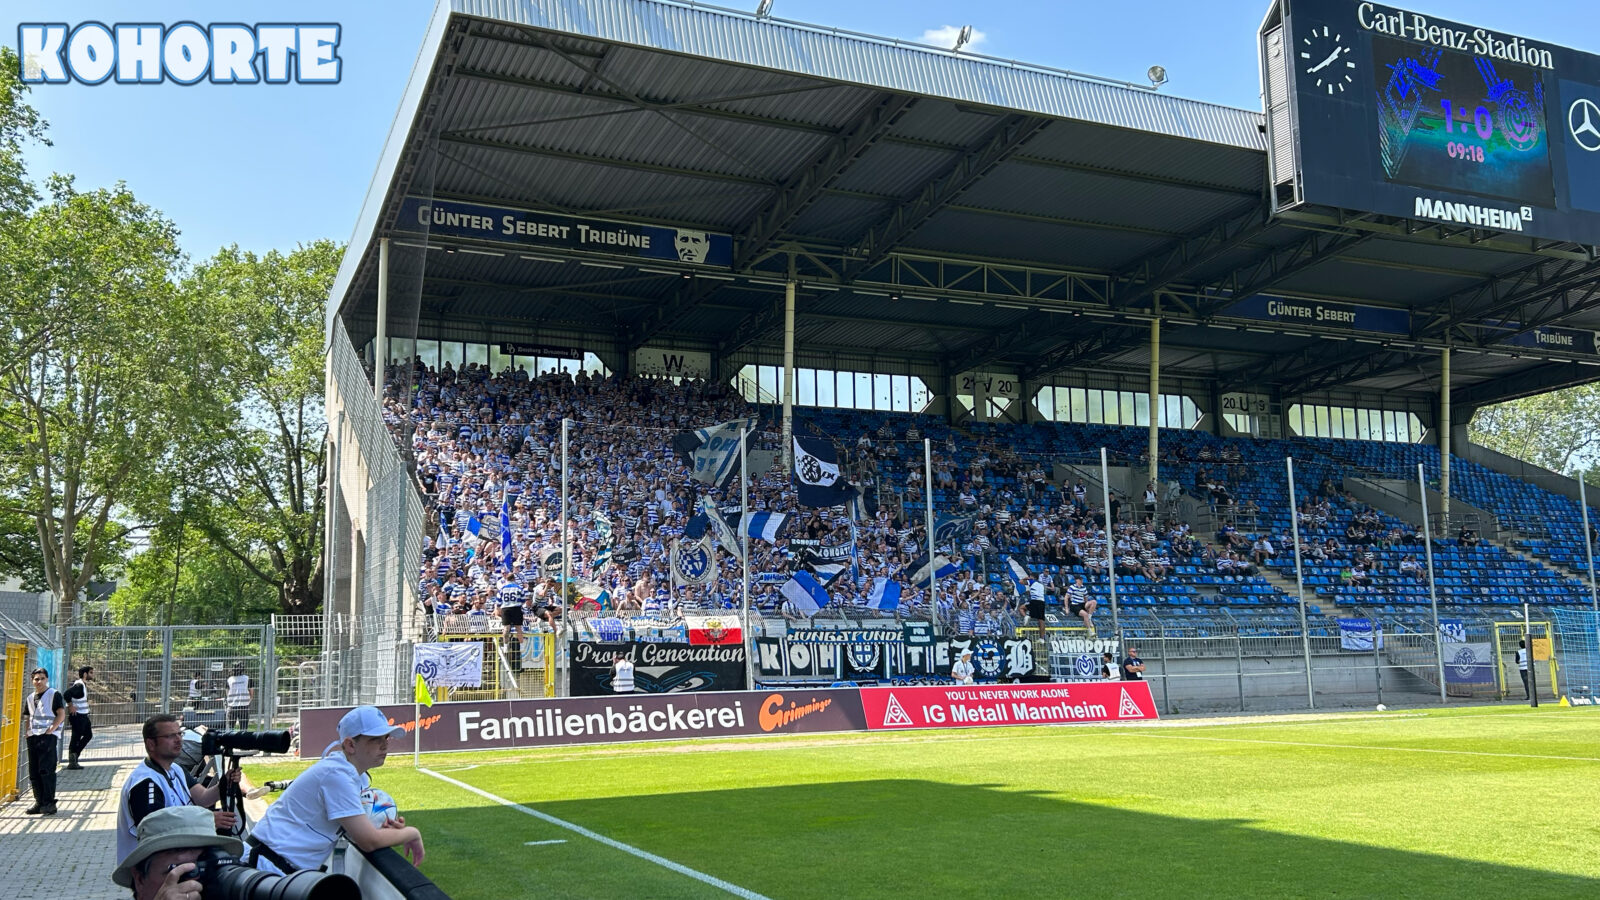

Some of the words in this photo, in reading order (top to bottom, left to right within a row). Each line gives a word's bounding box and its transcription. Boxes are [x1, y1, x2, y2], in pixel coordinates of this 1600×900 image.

[1357, 2, 1554, 69] Carl-Benz-Stadion
[1447, 141, 1485, 163] 09:18
[417, 205, 494, 231] GÜNTER
[502, 215, 570, 239] SEBERT
[577, 224, 651, 249] TRIBÜNE
[1268, 301, 1312, 318] GÜNTER
[1316, 305, 1356, 323] SEBERT
[1534, 330, 1573, 345] TRIBÜNE
[663, 354, 684, 372] W
[998, 380, 1012, 393] 20
[1224, 397, 1235, 409] 20
[503, 593, 516, 602] 66
[642, 643, 745, 666] Generation
[1051, 638, 1119, 654] RUHRPOTT
[980, 690, 1009, 699] NEVER
[1011, 689, 1038, 698] WORK
[1041, 688, 1069, 697] ALONE
[458, 700, 744, 741] Familienbäckerei
[759, 694, 831, 732] Grimminger
[922, 704, 945, 723] IG
[948, 703, 1008, 722] Metall
[1012, 701, 1107, 720] Mannheim
